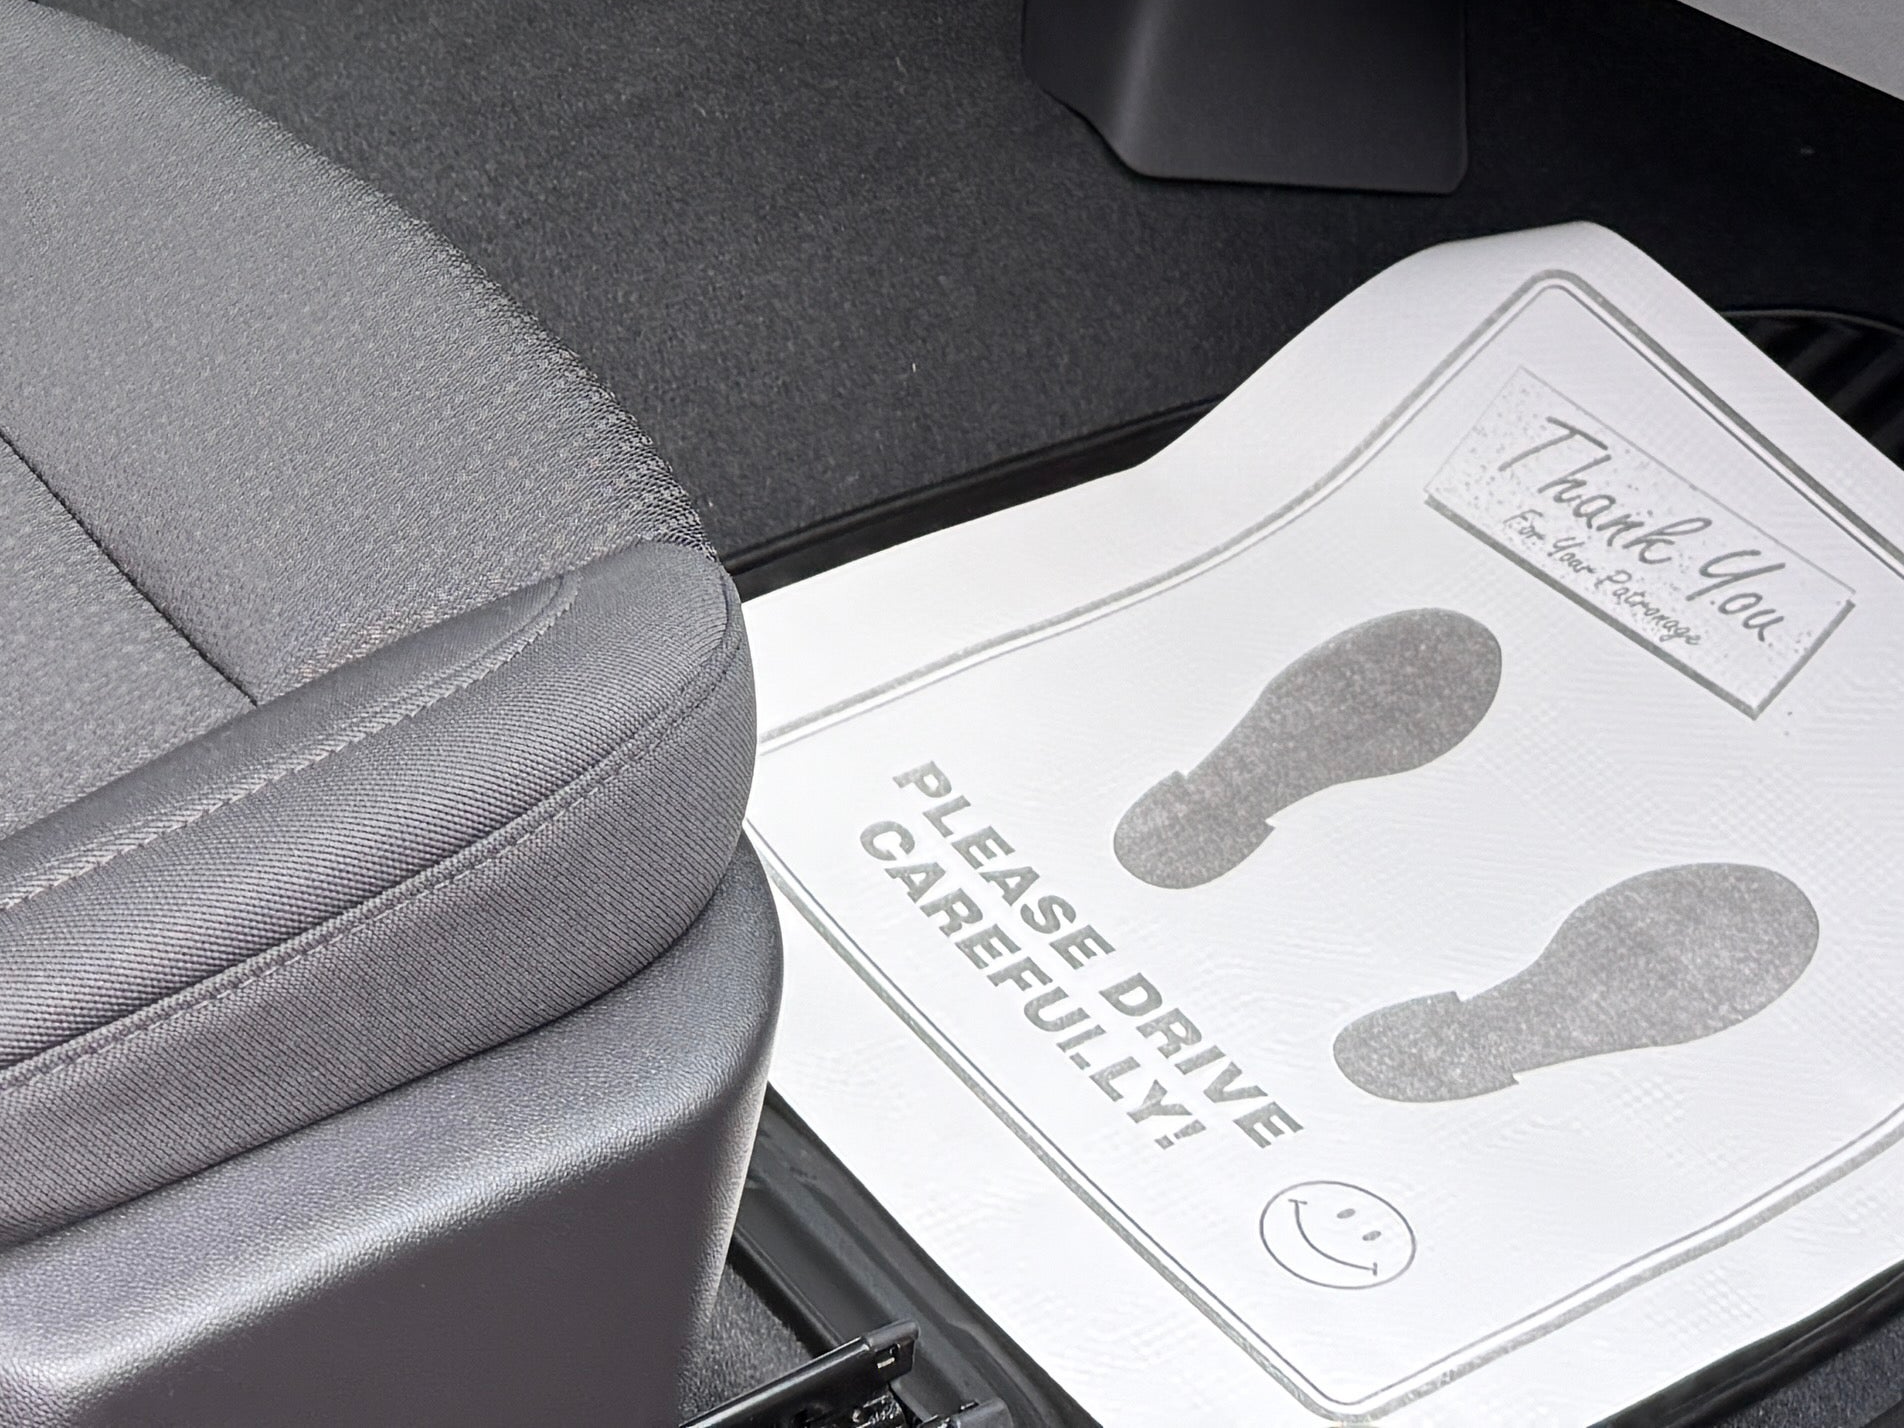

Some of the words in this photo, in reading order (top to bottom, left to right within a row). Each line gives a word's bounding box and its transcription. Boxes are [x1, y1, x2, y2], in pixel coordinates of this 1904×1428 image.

[1498, 415, 1713, 565] Thank
[1685, 549, 1786, 642] You
[1502, 508, 1544, 542] For
[1594, 569, 1701, 644] Patronage
[859, 819, 1208, 1151] CAREFULLY!
[892, 759, 1117, 971] PLEASE
[1097, 971, 1304, 1149] DRIVE
